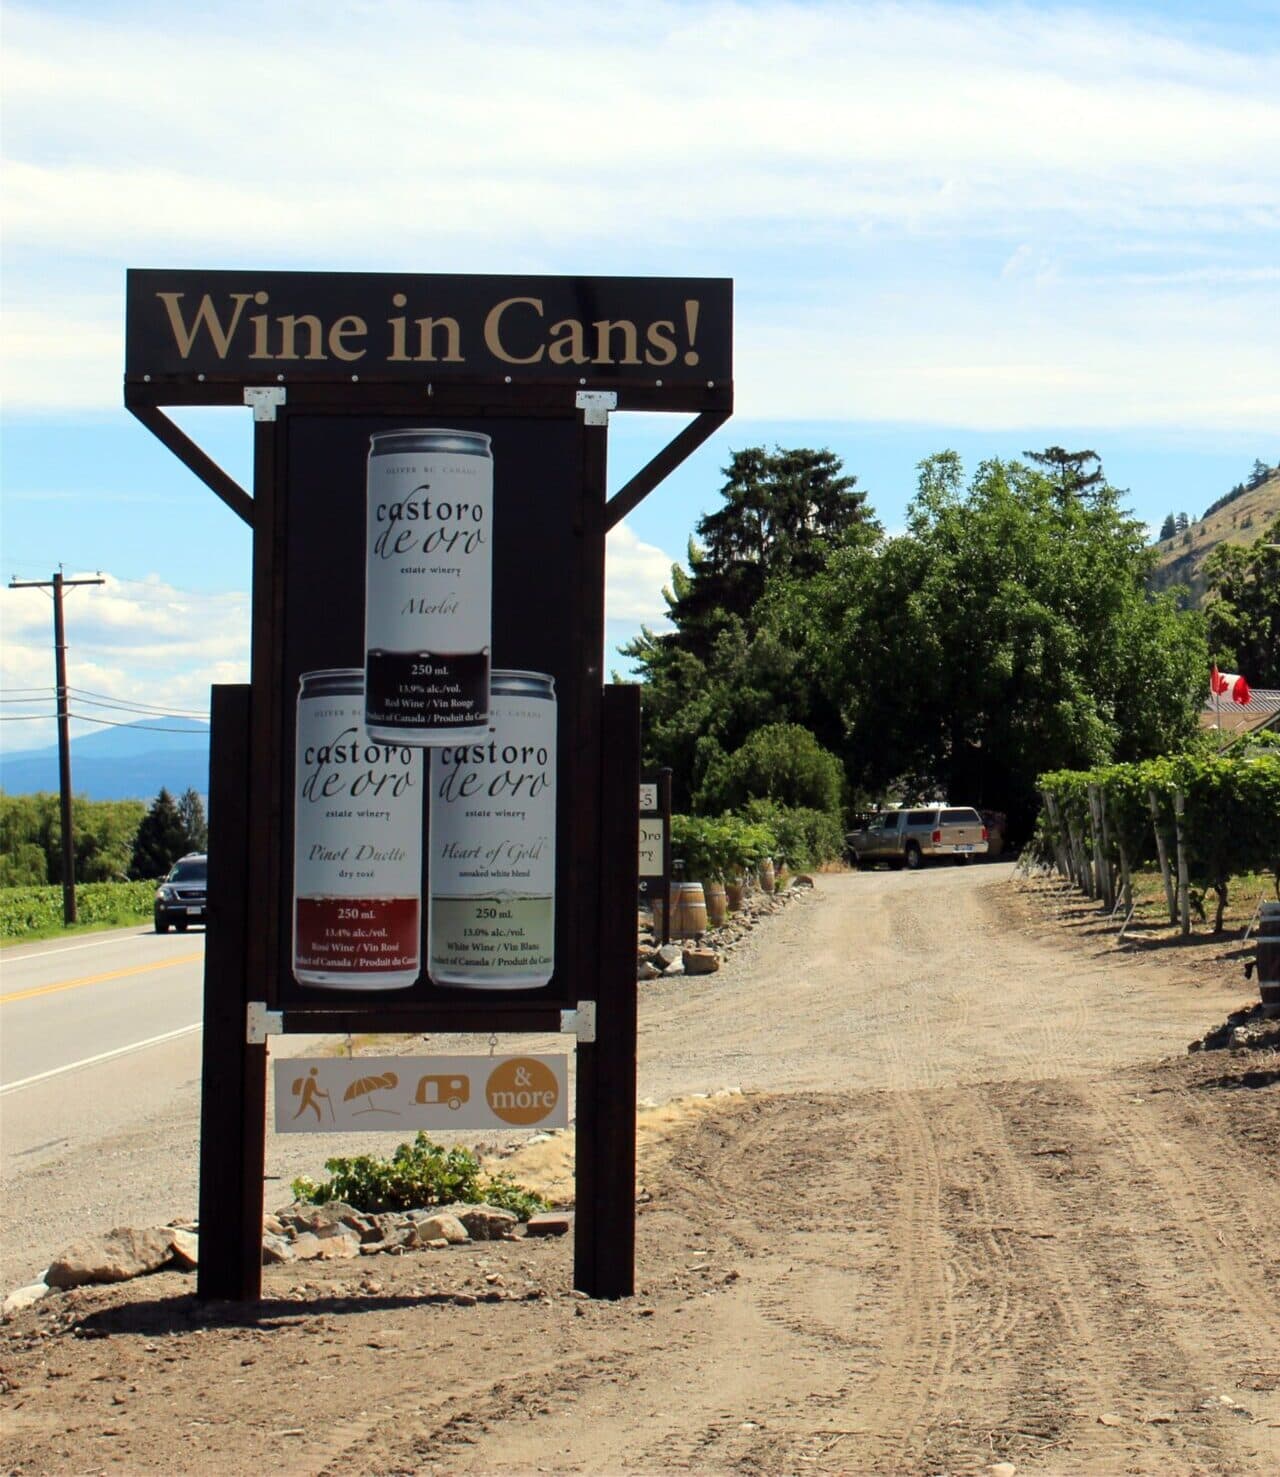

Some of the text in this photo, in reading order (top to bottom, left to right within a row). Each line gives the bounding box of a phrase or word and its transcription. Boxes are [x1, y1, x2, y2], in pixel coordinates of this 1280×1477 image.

[156, 292, 700, 366] Wine in Cans!
[377, 497, 483, 522] castoro
[423, 527, 488, 555] oro
[430, 567, 462, 577] winery
[401, 595, 459, 615] Merlot
[411, 664, 432, 675] 250
[401, 700, 424, 708] Wine
[433, 700, 449, 708] Vin
[305, 741, 411, 765] castoro
[441, 741, 548, 765] castoro
[302, 766, 414, 803] de oro
[439, 766, 549, 803] de oro
[325, 810, 390, 821] estate winery
[465, 810, 526, 821] estate winery
[309, 844, 349, 862] Pinot
[441, 840, 544, 865] Heart of Gold
[339, 870, 353, 878] dry
[512, 869, 531, 877] blend
[337, 909, 359, 919] 250
[476, 909, 497, 919] 250
[331, 943, 355, 952] Wine
[363, 943, 379, 952] Vin
[447, 942, 469, 951] White
[472, 943, 494, 952] Wine
[504, 943, 519, 952] Vin
[514, 1066, 531, 1087] &
[492, 1088, 555, 1109] more
